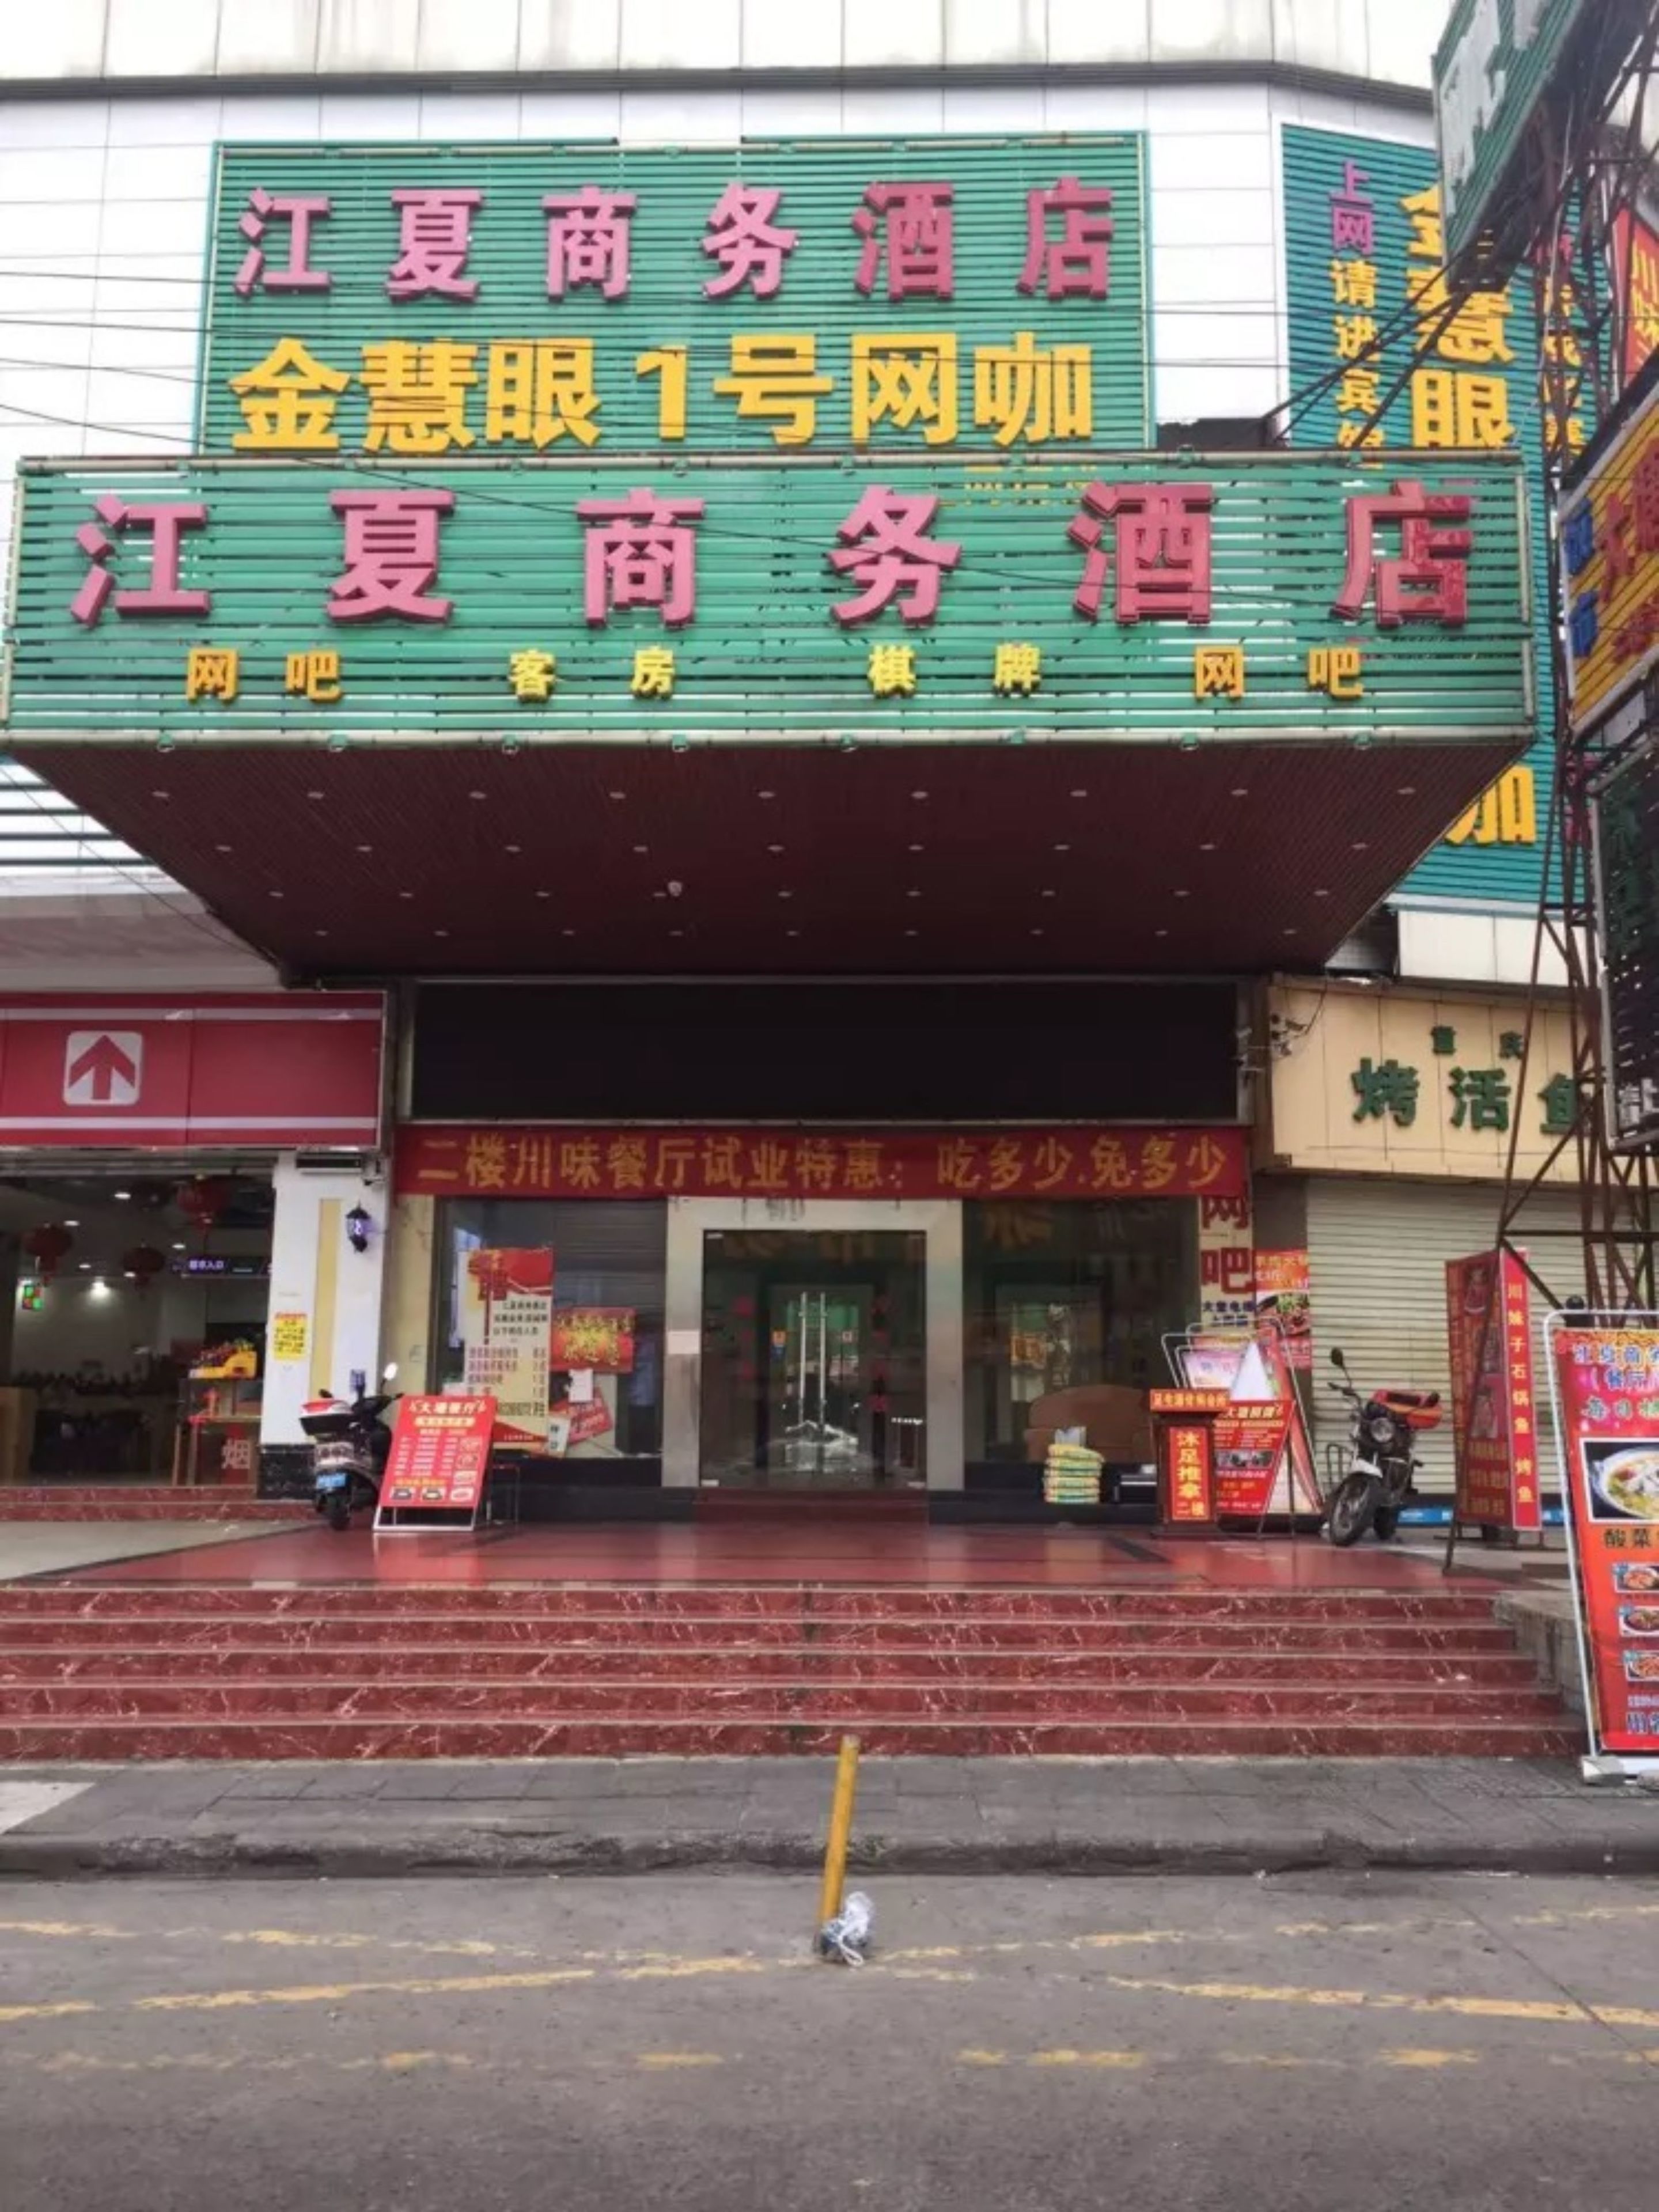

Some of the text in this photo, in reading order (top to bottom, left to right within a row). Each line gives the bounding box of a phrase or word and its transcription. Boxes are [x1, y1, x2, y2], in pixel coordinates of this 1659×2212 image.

[233, 177, 1113, 301] 江夏商务酒店
[229, 332, 1093, 452] 金慧眼1号网咖
[70, 479, 1473, 628] 江夏商务酒店
[185, 644, 1363, 703] 网吧 客房 棋牌 网吧
[1200, 1196, 1254, 1295] 网吧
[221, 1438, 251, 1469] 烟
